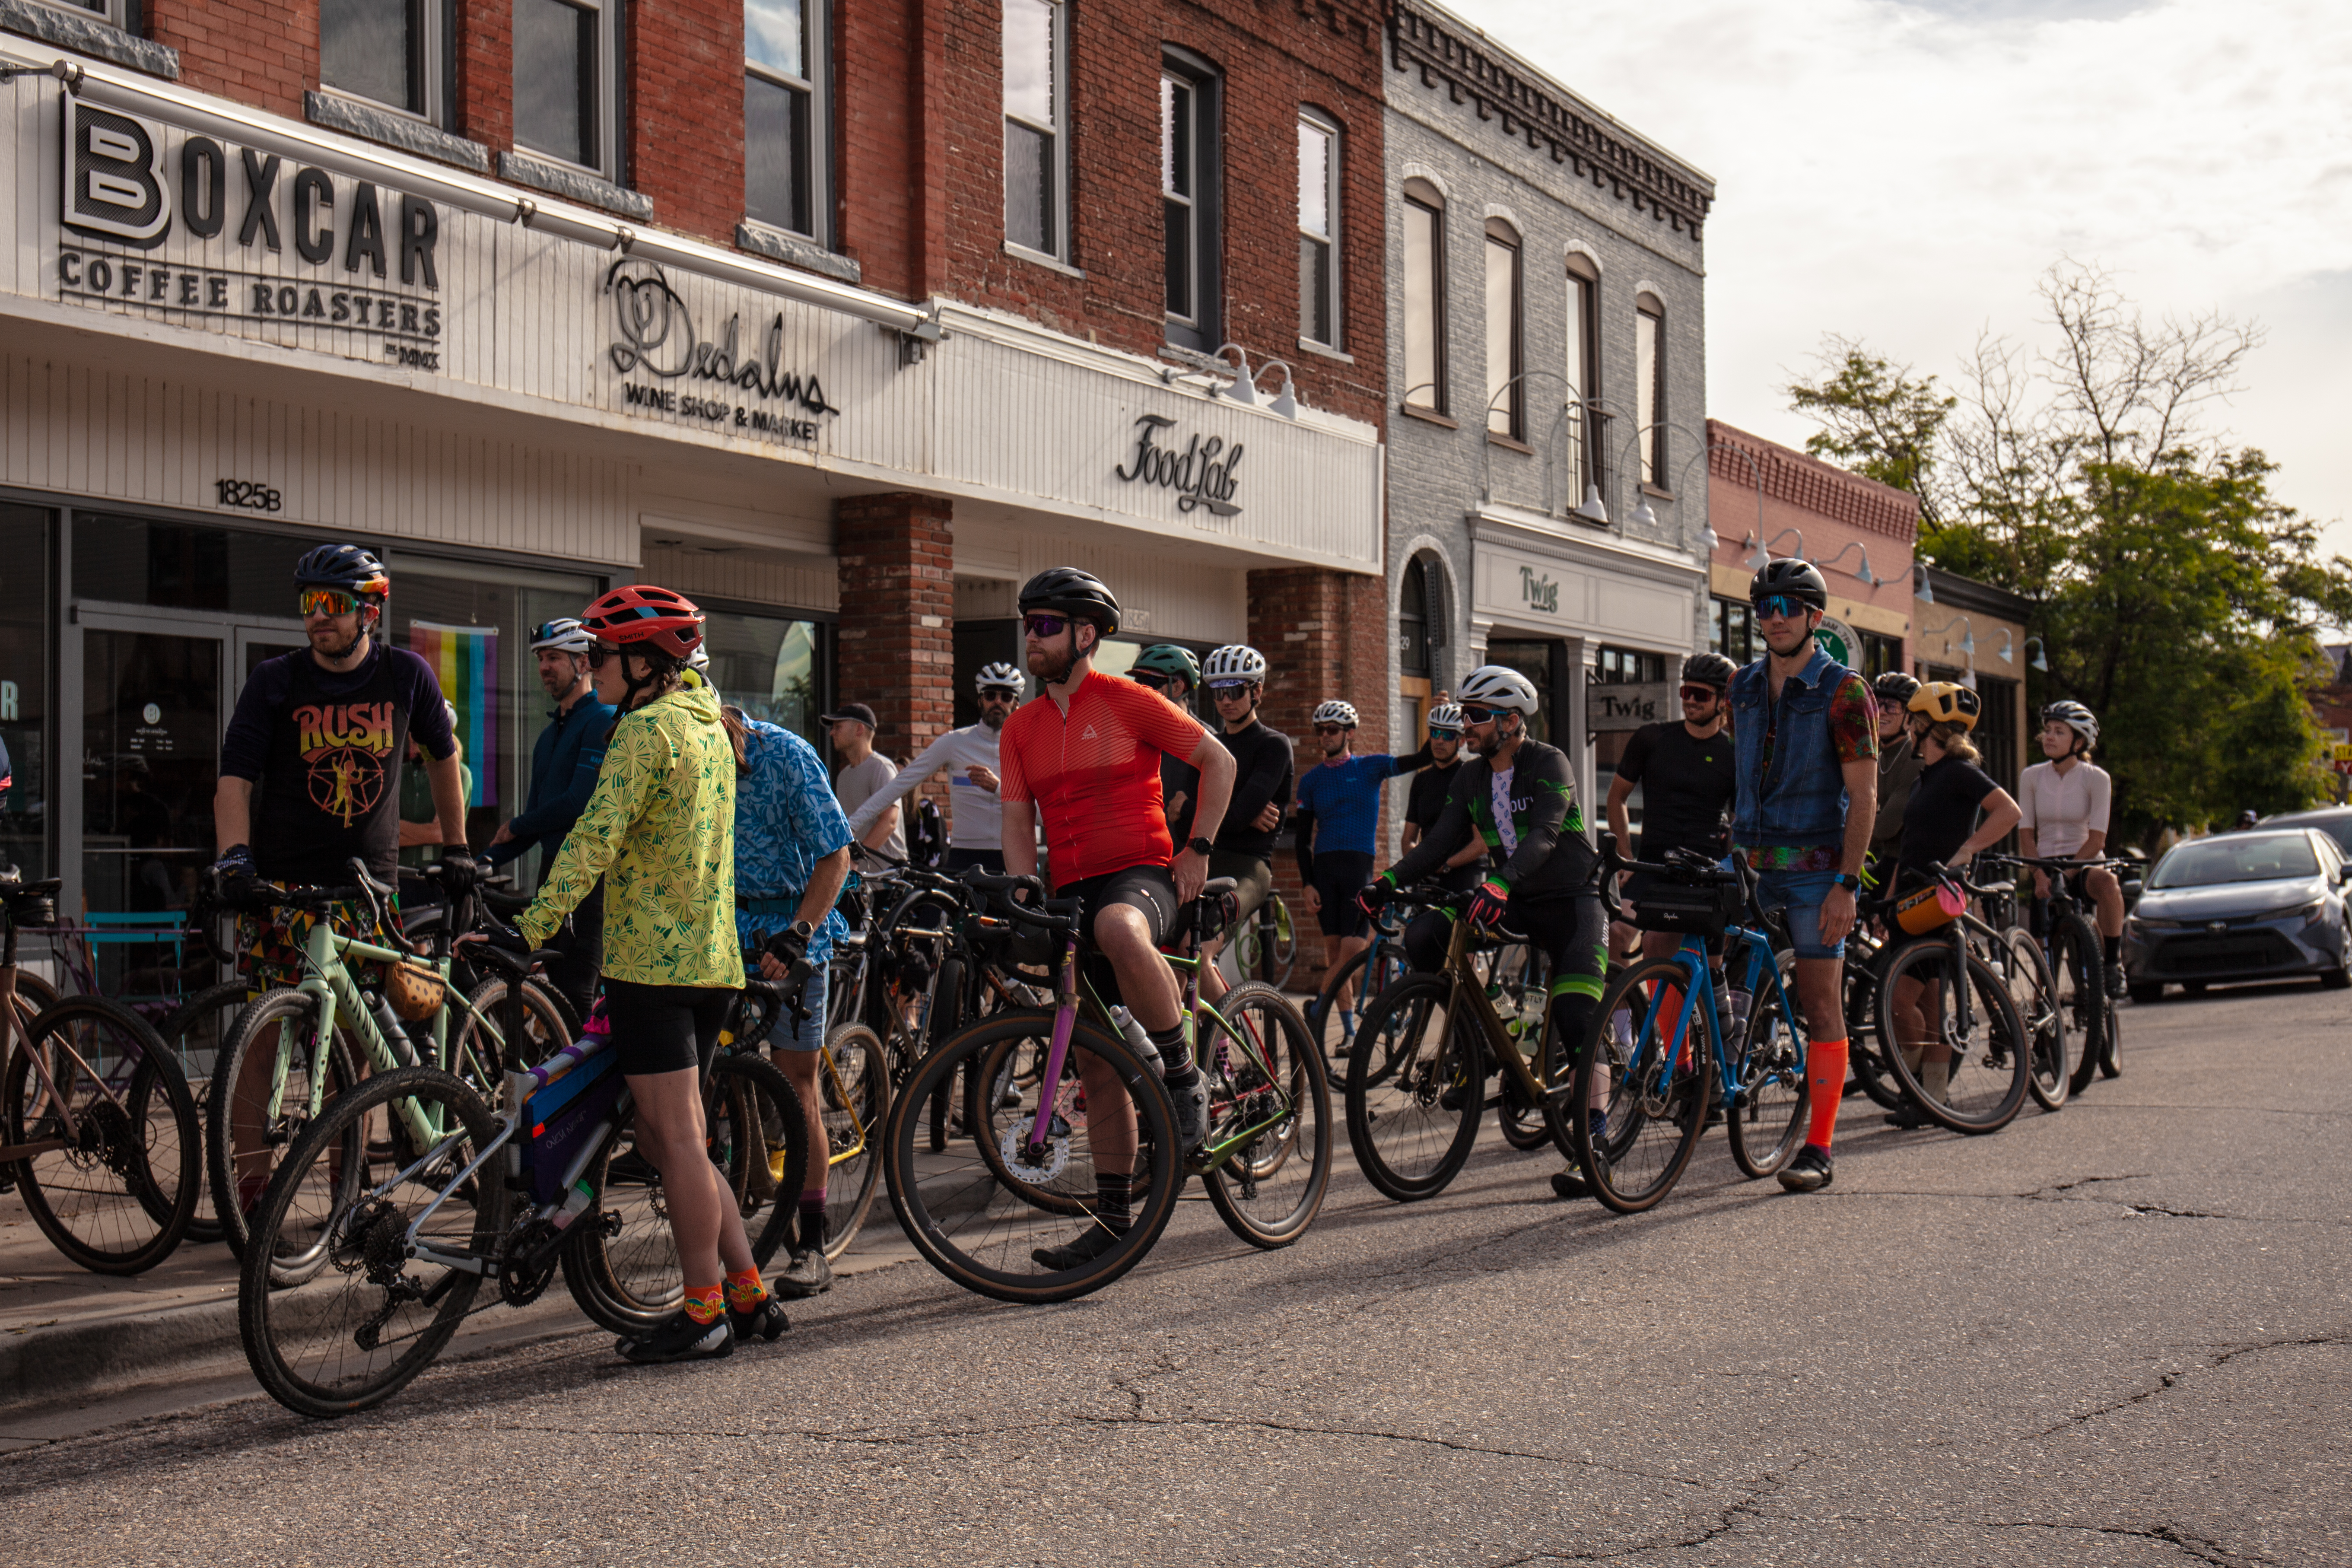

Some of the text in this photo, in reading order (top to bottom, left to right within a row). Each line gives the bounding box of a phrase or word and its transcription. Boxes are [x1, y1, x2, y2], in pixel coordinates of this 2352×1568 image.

[61, 91, 439, 291] BOXCAR
[60, 253, 441, 337] COFFEE ROASTERS
[606, 258, 839, 416] Dedalus
[400, 346, 440, 370] MMX
[626, 382, 823, 442] WINE SHOP & MARKET
[215, 479, 281, 511] 1825B
[1520, 566, 1558, 613] Twig
[619, 632, 644, 641] SMITH
[1821, 620, 1838, 630] 9AM
[1841, 631, 1853, 649] 7PM
[1601, 695, 1655, 720] Twig
[292, 701, 394, 757] RUSH
[590, 755, 603, 764] RAP
[1664, 913, 1679, 921] Rapha
[1525, 995, 1543, 1004] UTLY
[1702, 1054, 1706, 1064] DT
